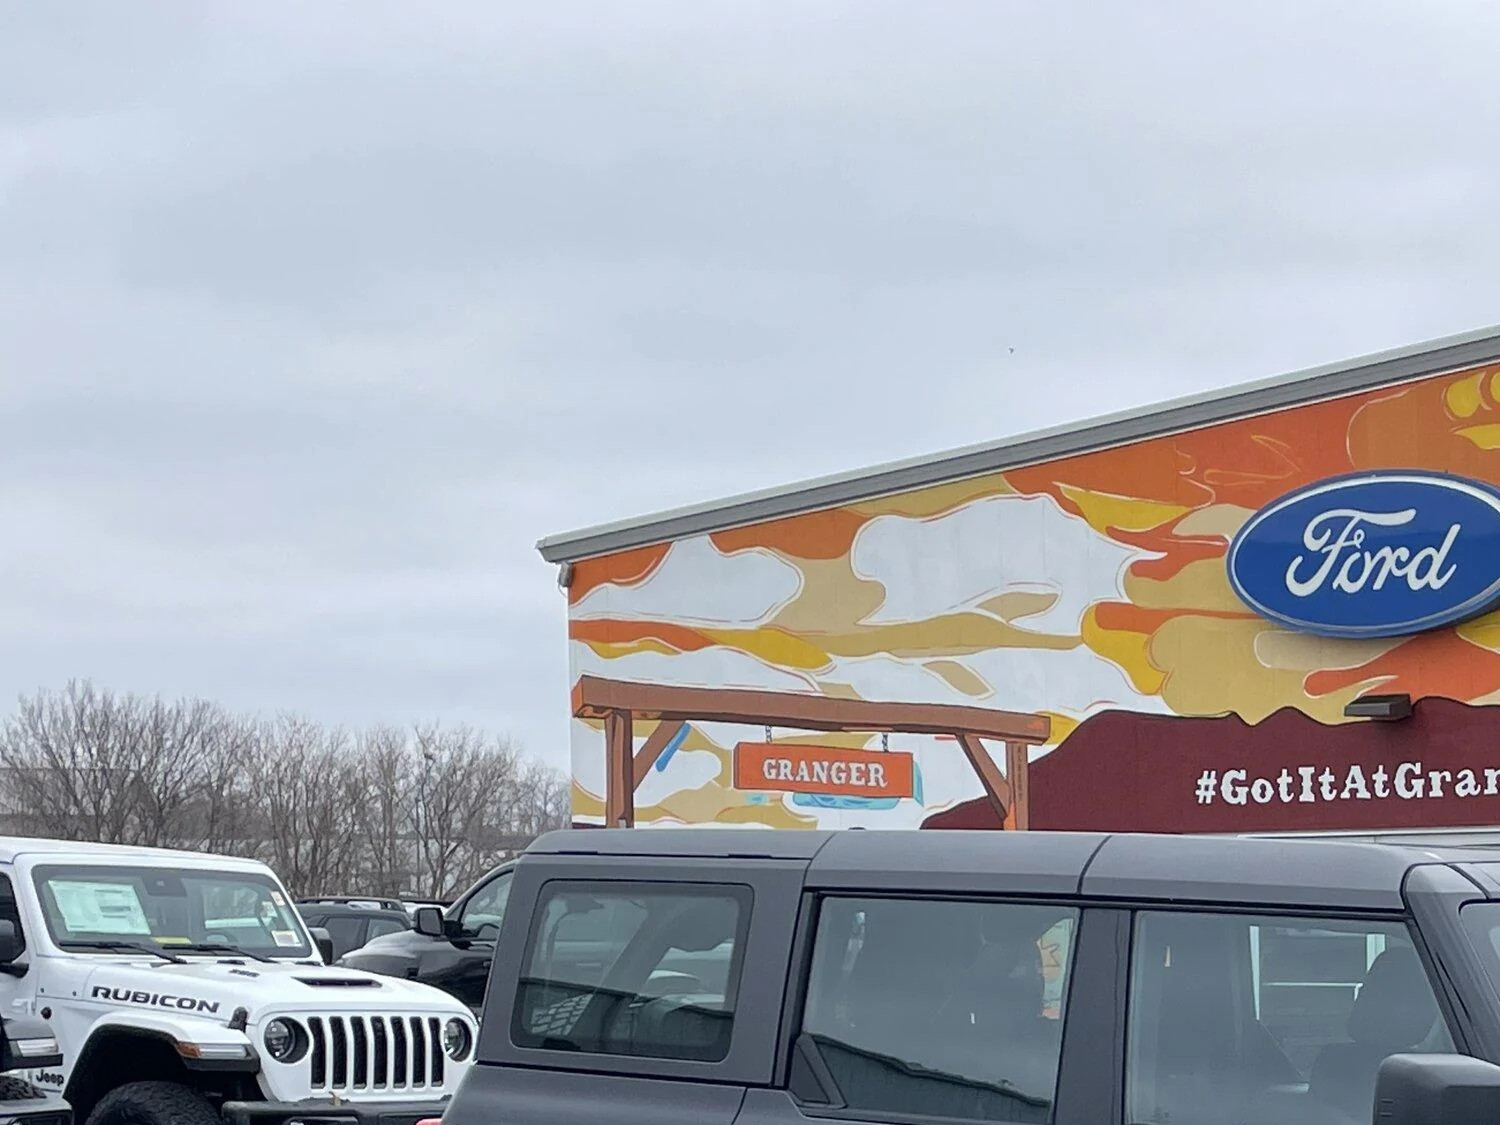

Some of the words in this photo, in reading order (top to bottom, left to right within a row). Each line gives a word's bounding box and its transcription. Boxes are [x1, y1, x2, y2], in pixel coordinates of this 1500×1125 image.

[1286, 508, 1461, 597] Ford
[764, 758, 887, 788] GRANGER
[91, 986, 220, 1013] RUBICON
[36, 1069, 64, 1087] Jeep
